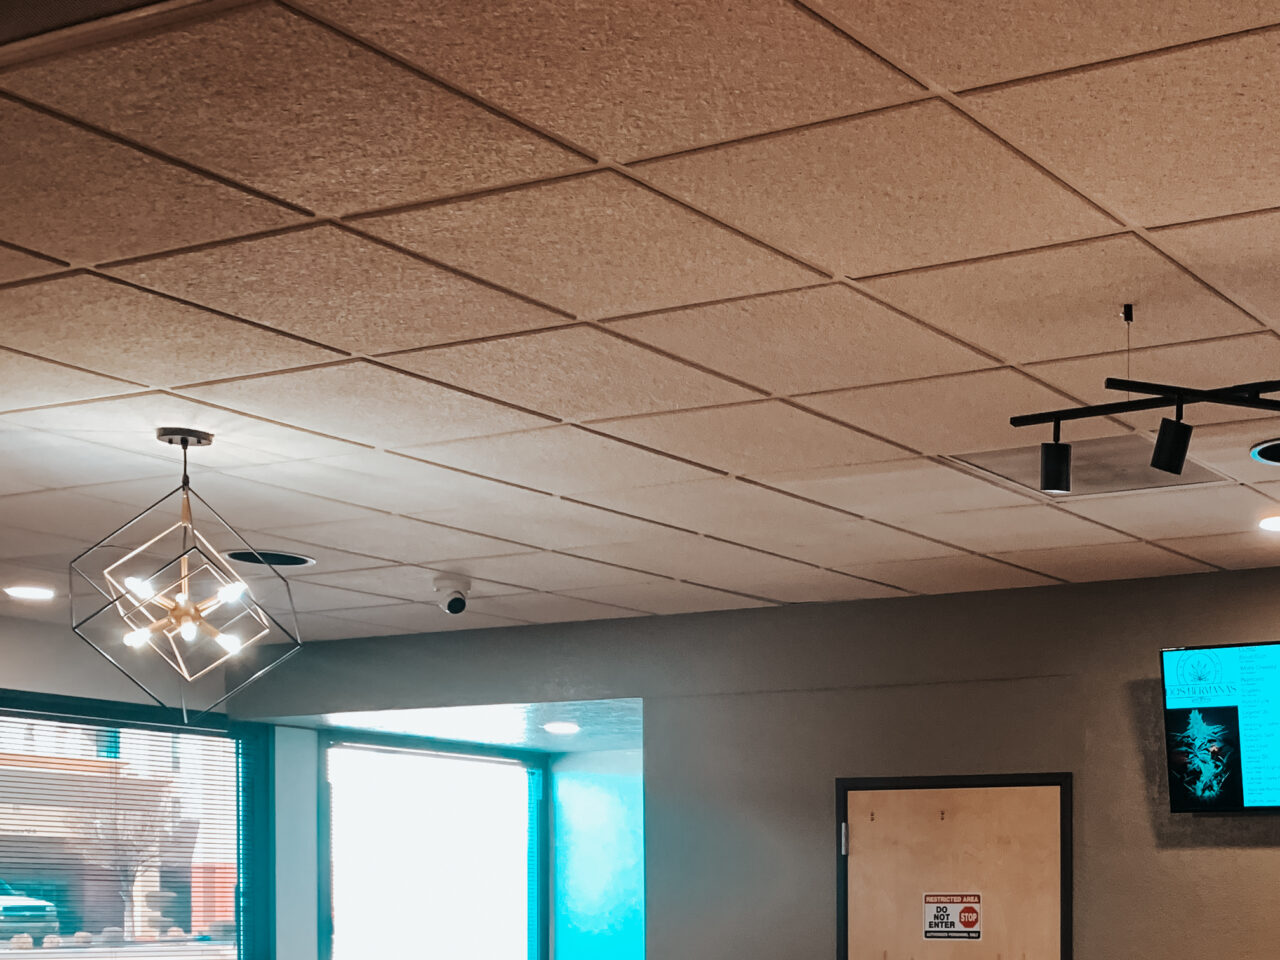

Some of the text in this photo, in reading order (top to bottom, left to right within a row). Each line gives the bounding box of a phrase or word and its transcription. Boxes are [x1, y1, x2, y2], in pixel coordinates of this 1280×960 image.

[933, 913, 951, 921] NOT
[960, 912, 978, 922] STOP
[928, 921, 956, 929] ENTER
